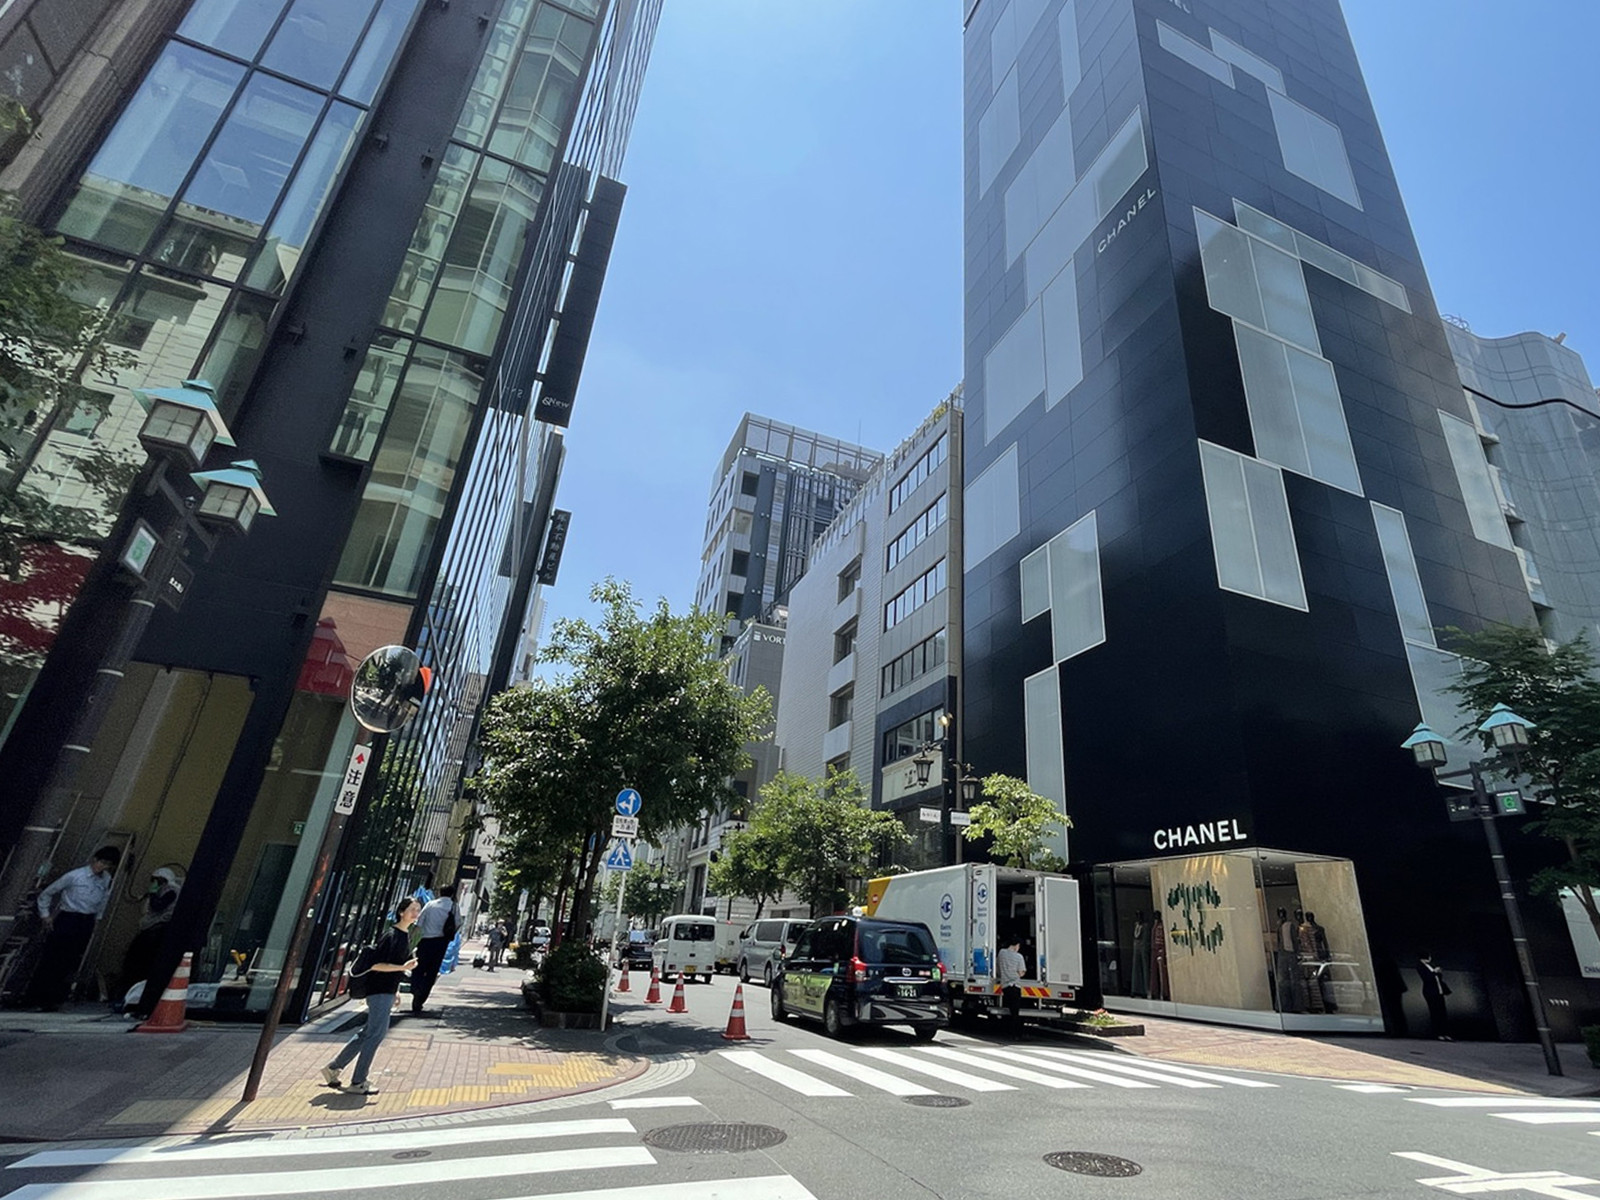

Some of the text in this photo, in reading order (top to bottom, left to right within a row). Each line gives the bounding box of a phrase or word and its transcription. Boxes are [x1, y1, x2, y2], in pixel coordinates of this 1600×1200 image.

[1098, 188, 1156, 253] CHANEL
[340, 768, 362, 808] 注意
[1153, 819, 1247, 849] CHANEL
